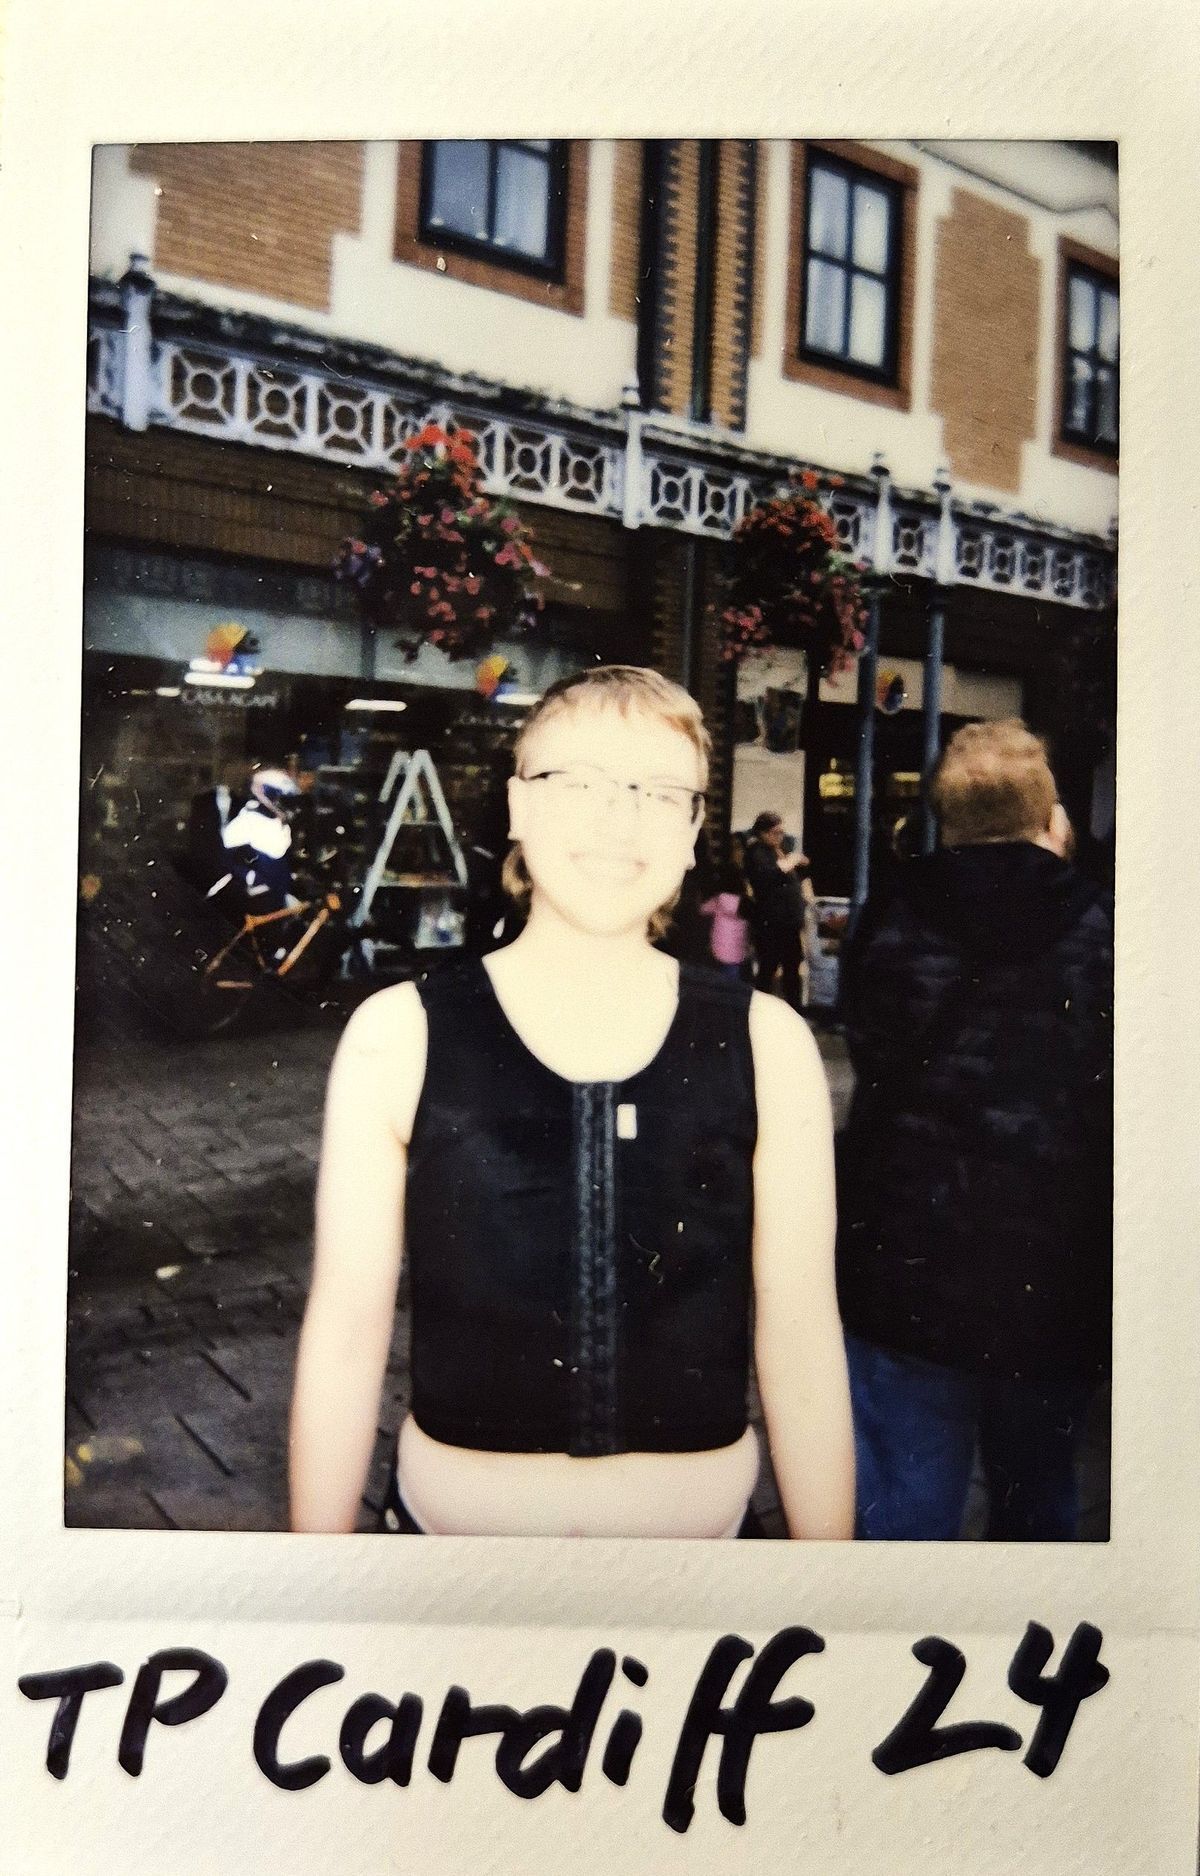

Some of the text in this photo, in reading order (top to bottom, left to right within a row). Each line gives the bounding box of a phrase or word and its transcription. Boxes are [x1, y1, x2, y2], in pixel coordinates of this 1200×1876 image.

[18, 1621, 1112, 1834] TP Cardiff 24
